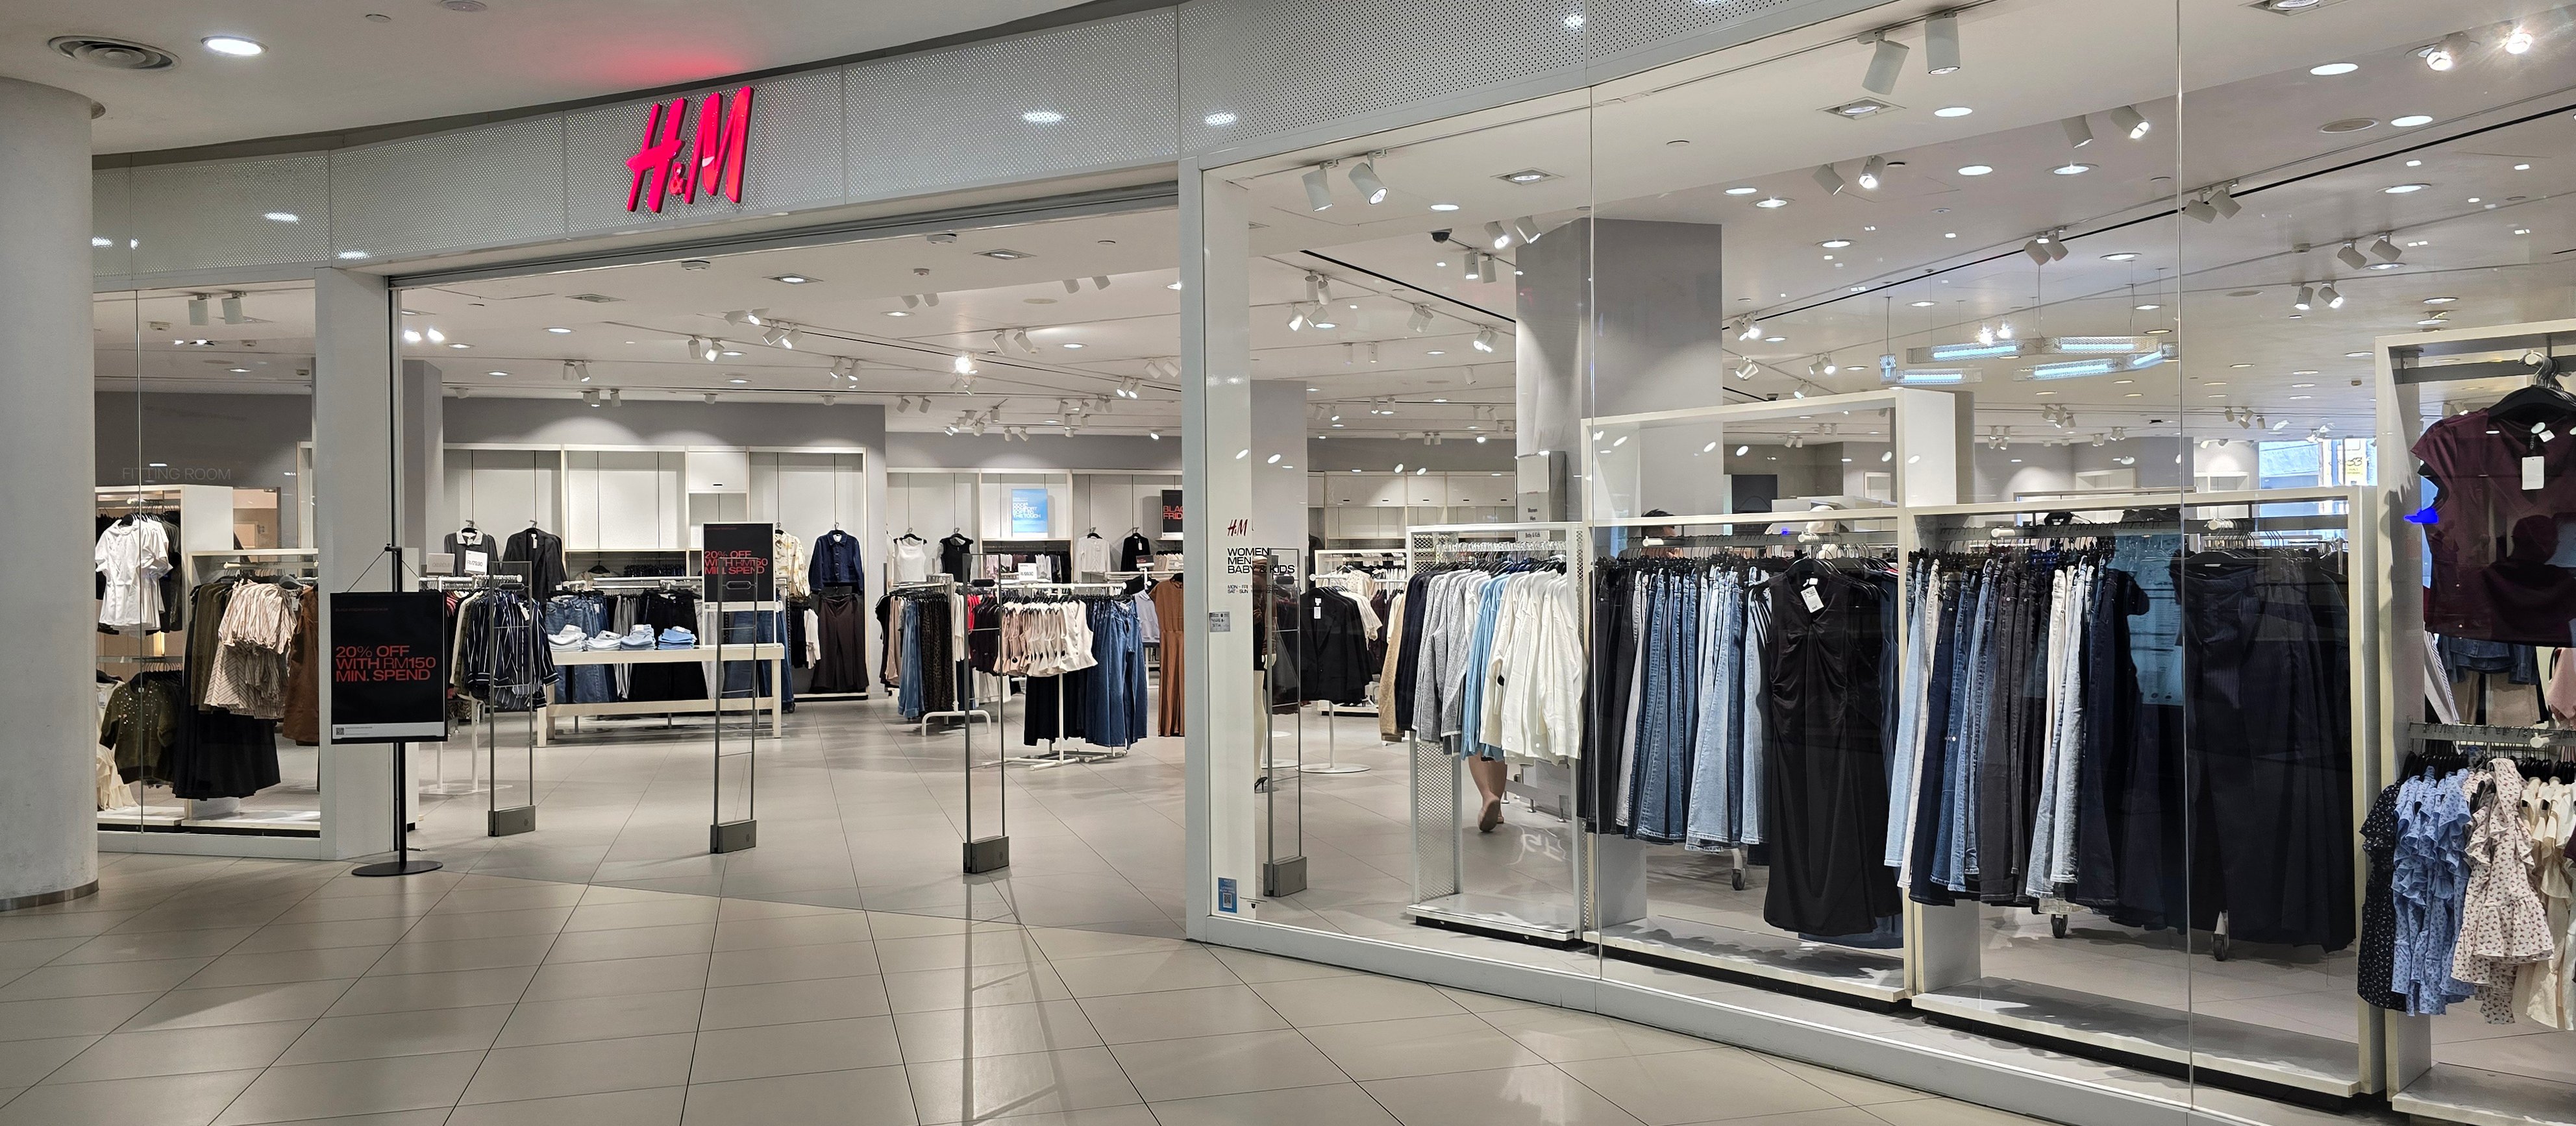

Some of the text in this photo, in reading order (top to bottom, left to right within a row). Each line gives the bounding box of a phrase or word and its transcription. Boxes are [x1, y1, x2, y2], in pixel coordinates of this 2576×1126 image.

[625, 86, 754, 213] H&M
[184, 468, 231, 480] ROOM
[1227, 519, 1248, 536] H&M
[1227, 548, 1270, 556] WOMEN
[728, 566, 765, 574] SPEND
[1228, 565, 1295, 574] BABY & KIDS
[336, 645, 410, 657] 20% OFF
[336, 657, 436, 670] WITH RM150
[336, 669, 430, 682] MIN. SPEND
